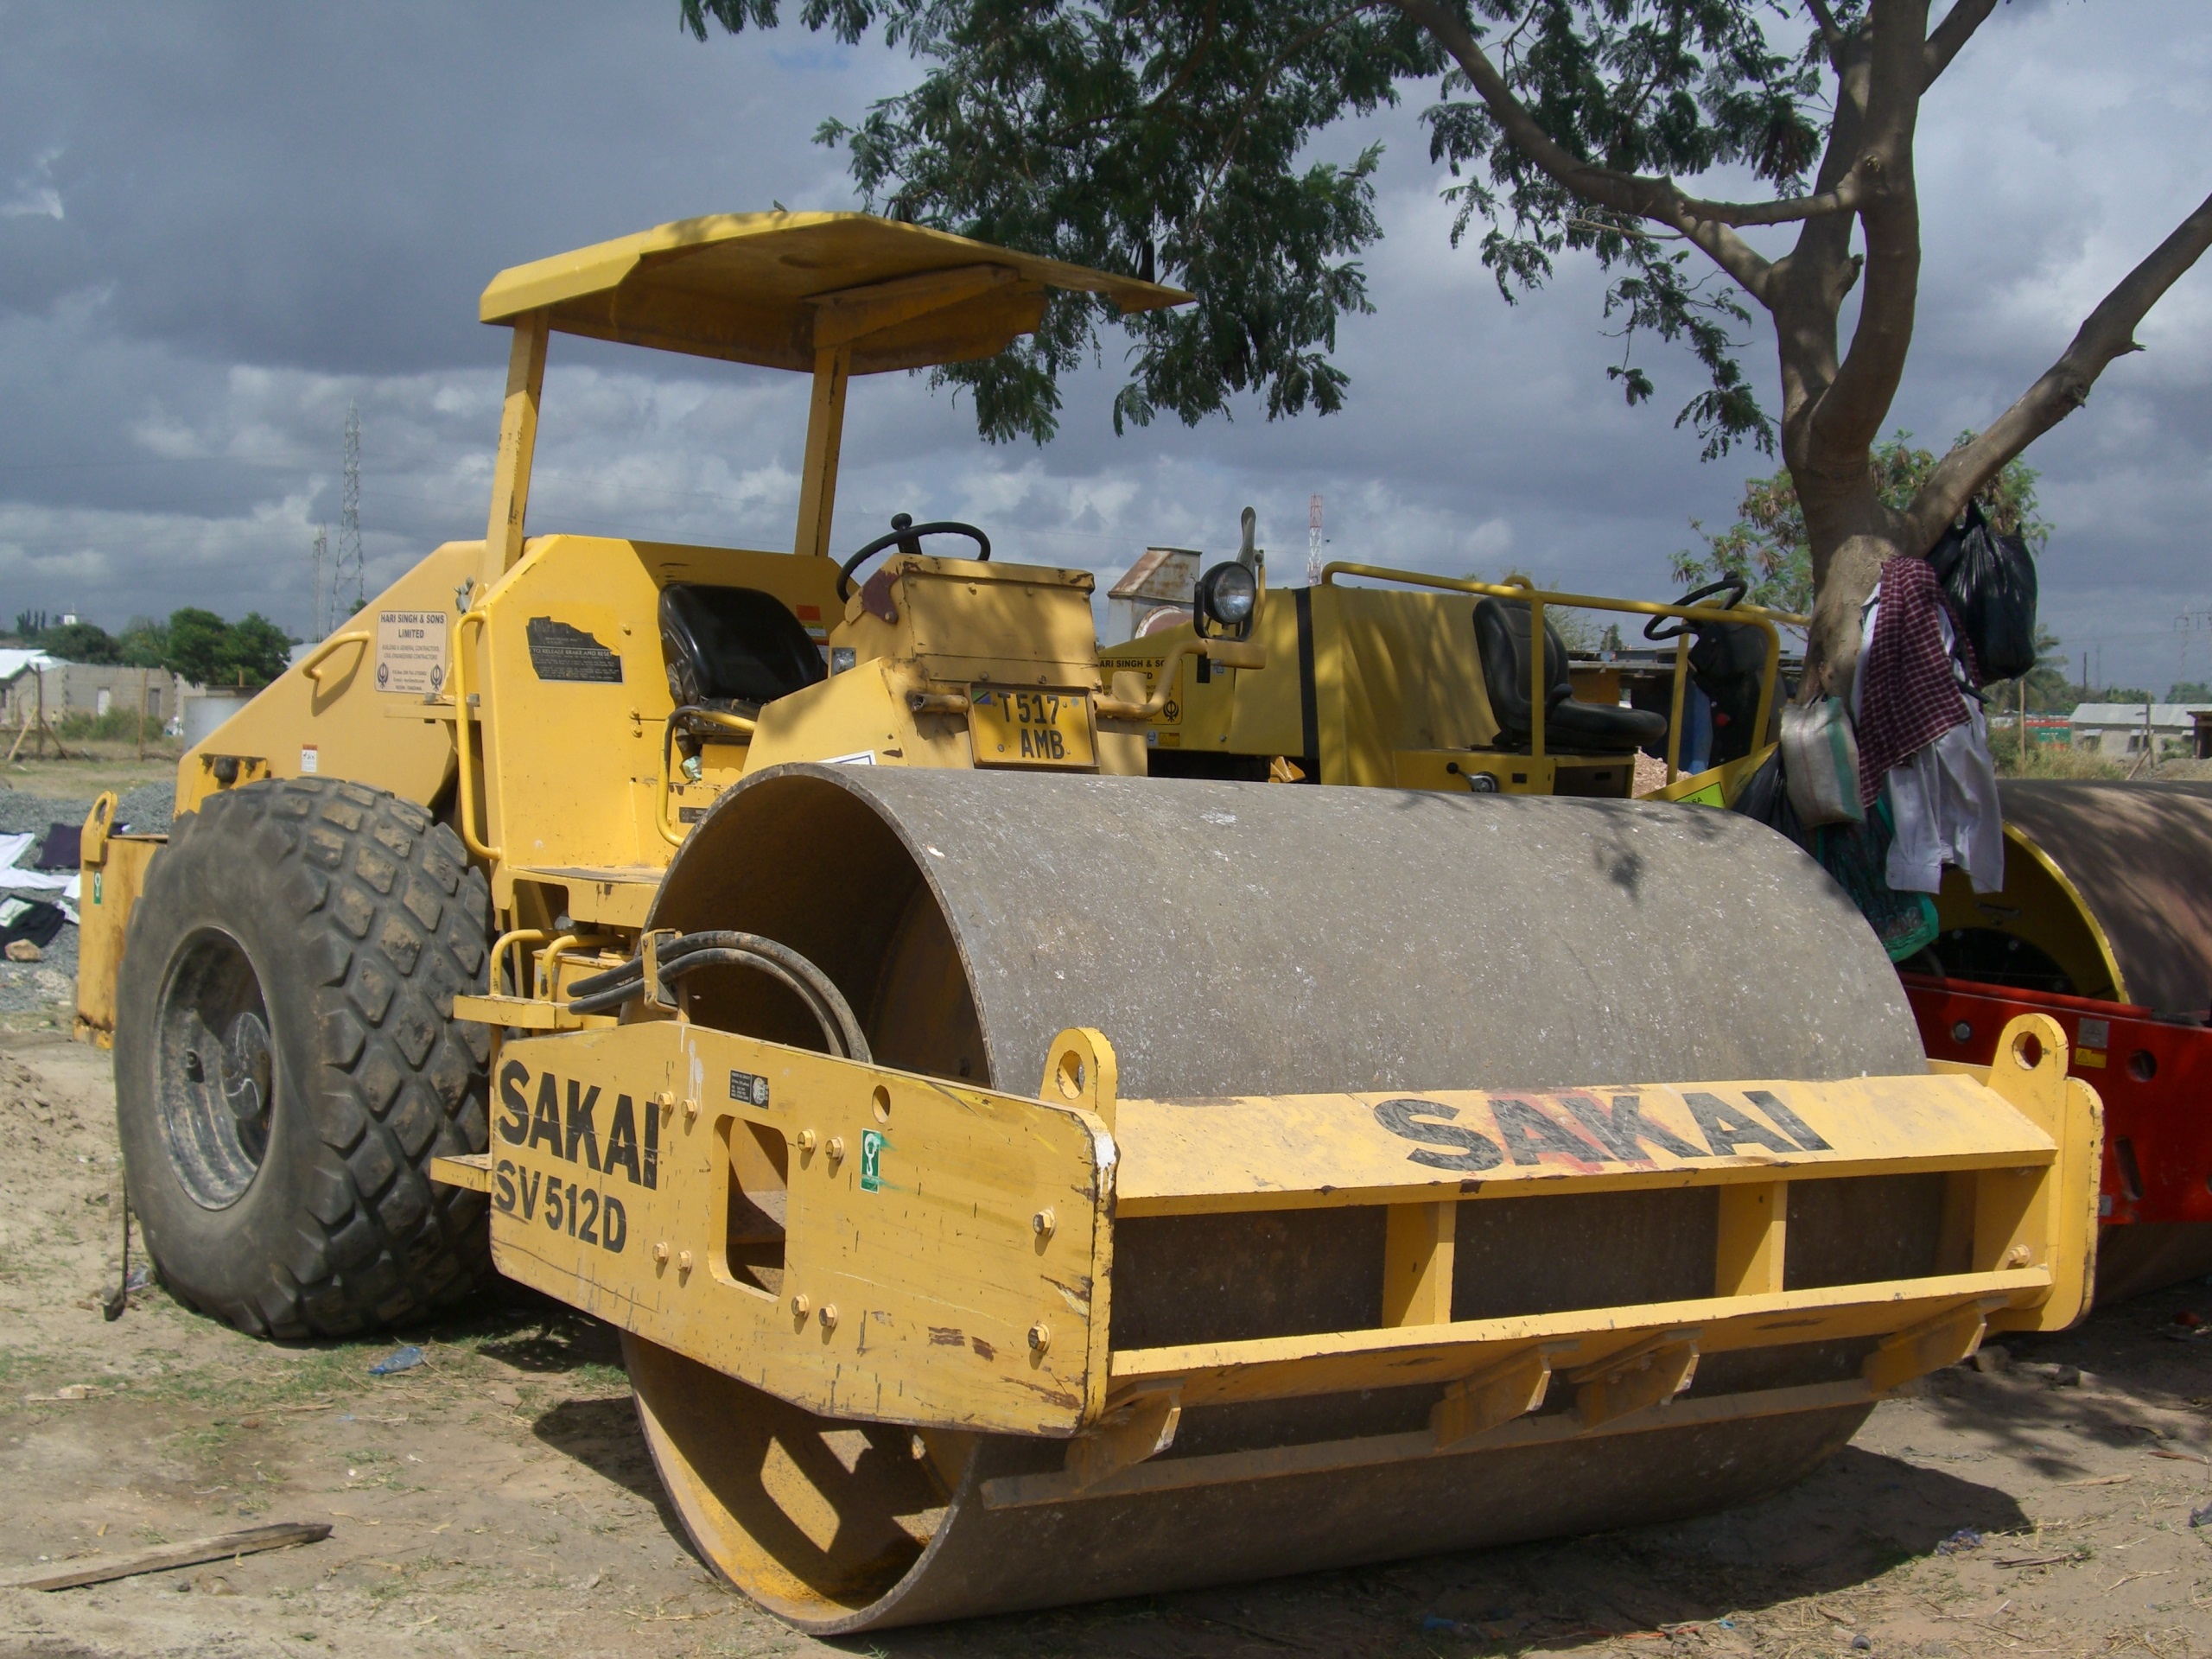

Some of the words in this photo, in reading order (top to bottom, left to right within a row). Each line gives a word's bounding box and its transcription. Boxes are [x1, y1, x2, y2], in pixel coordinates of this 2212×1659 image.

[381, 614, 396, 623] HARI
[397, 613, 418, 623] SINGH
[419, 614, 424, 623] &
[426, 614, 445, 624] SONS
[398, 629, 424, 639] LIMITED
[1100, 659, 1114, 668] ARI
[1116, 659, 1143, 668] SINGH
[1147, 659, 1153, 668] &
[1020, 728, 1065, 760] AMB
[499, 1059, 659, 1191] SAKAI
[1374, 1090, 1834, 1172] SAKAI
